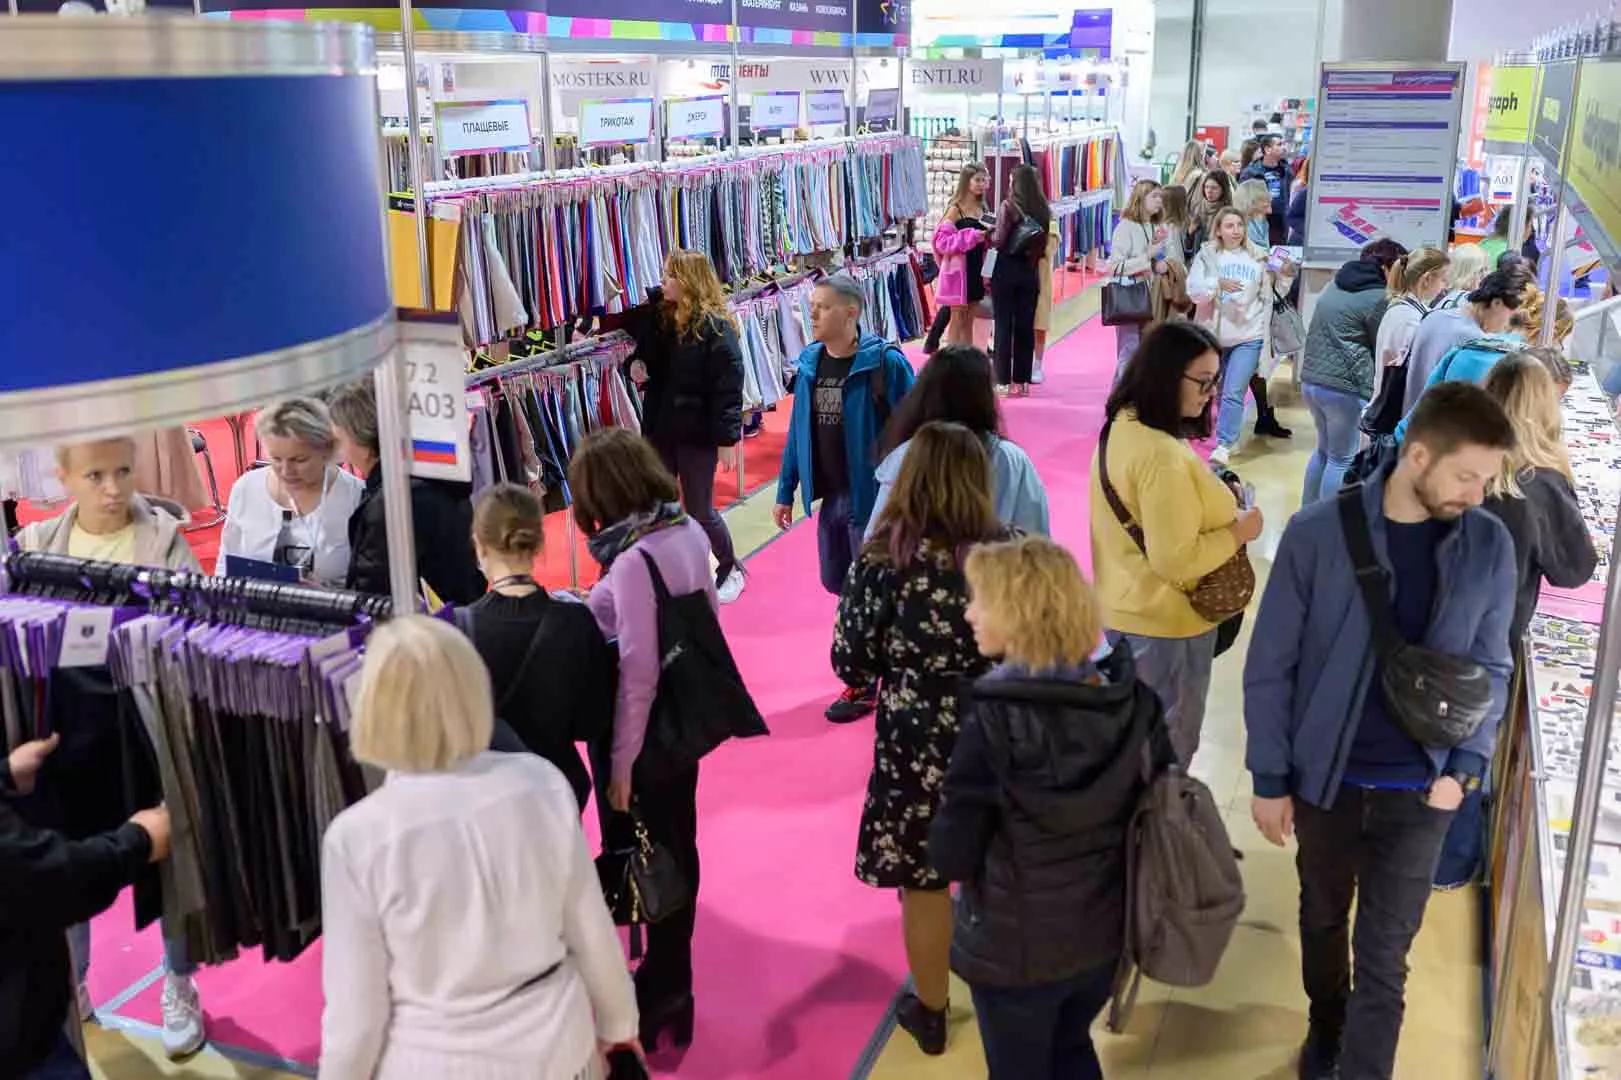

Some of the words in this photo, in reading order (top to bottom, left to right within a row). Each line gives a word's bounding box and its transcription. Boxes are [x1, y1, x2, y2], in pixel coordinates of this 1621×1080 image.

[552, 72, 650, 87] MOSTEKS.RU
[462, 120, 509, 134] ПЛАЩЕВЫЕ
[600, 116, 634, 128] ТРИКОТАЖ
[407, 391, 457, 420] A03
